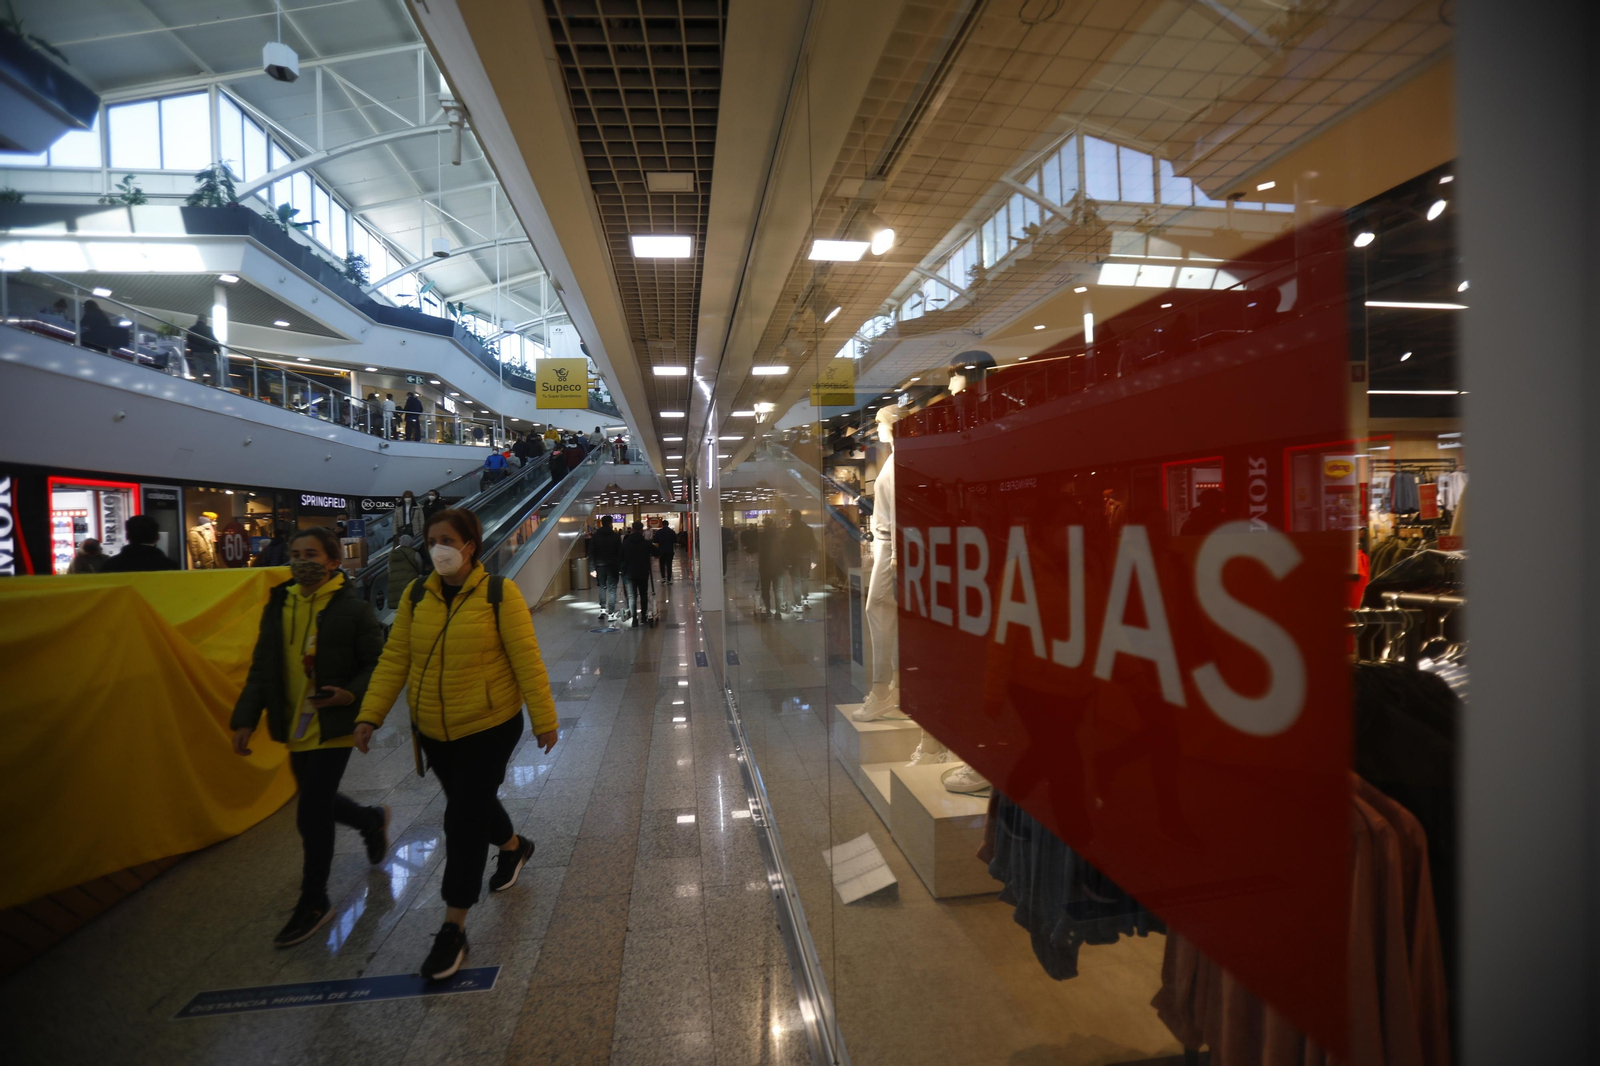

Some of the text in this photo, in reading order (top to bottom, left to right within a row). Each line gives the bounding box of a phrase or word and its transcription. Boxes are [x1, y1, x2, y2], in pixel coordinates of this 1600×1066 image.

[542, 382, 581, 393] Supeco
[301, 494, 346, 508] SPRINGFIELD
[103, 491, 117, 542] PRIMO
[903, 520, 1308, 737] REBAJAS
[190, 989, 372, 1013] DISTANCIA MÍNIMA DE 2M
